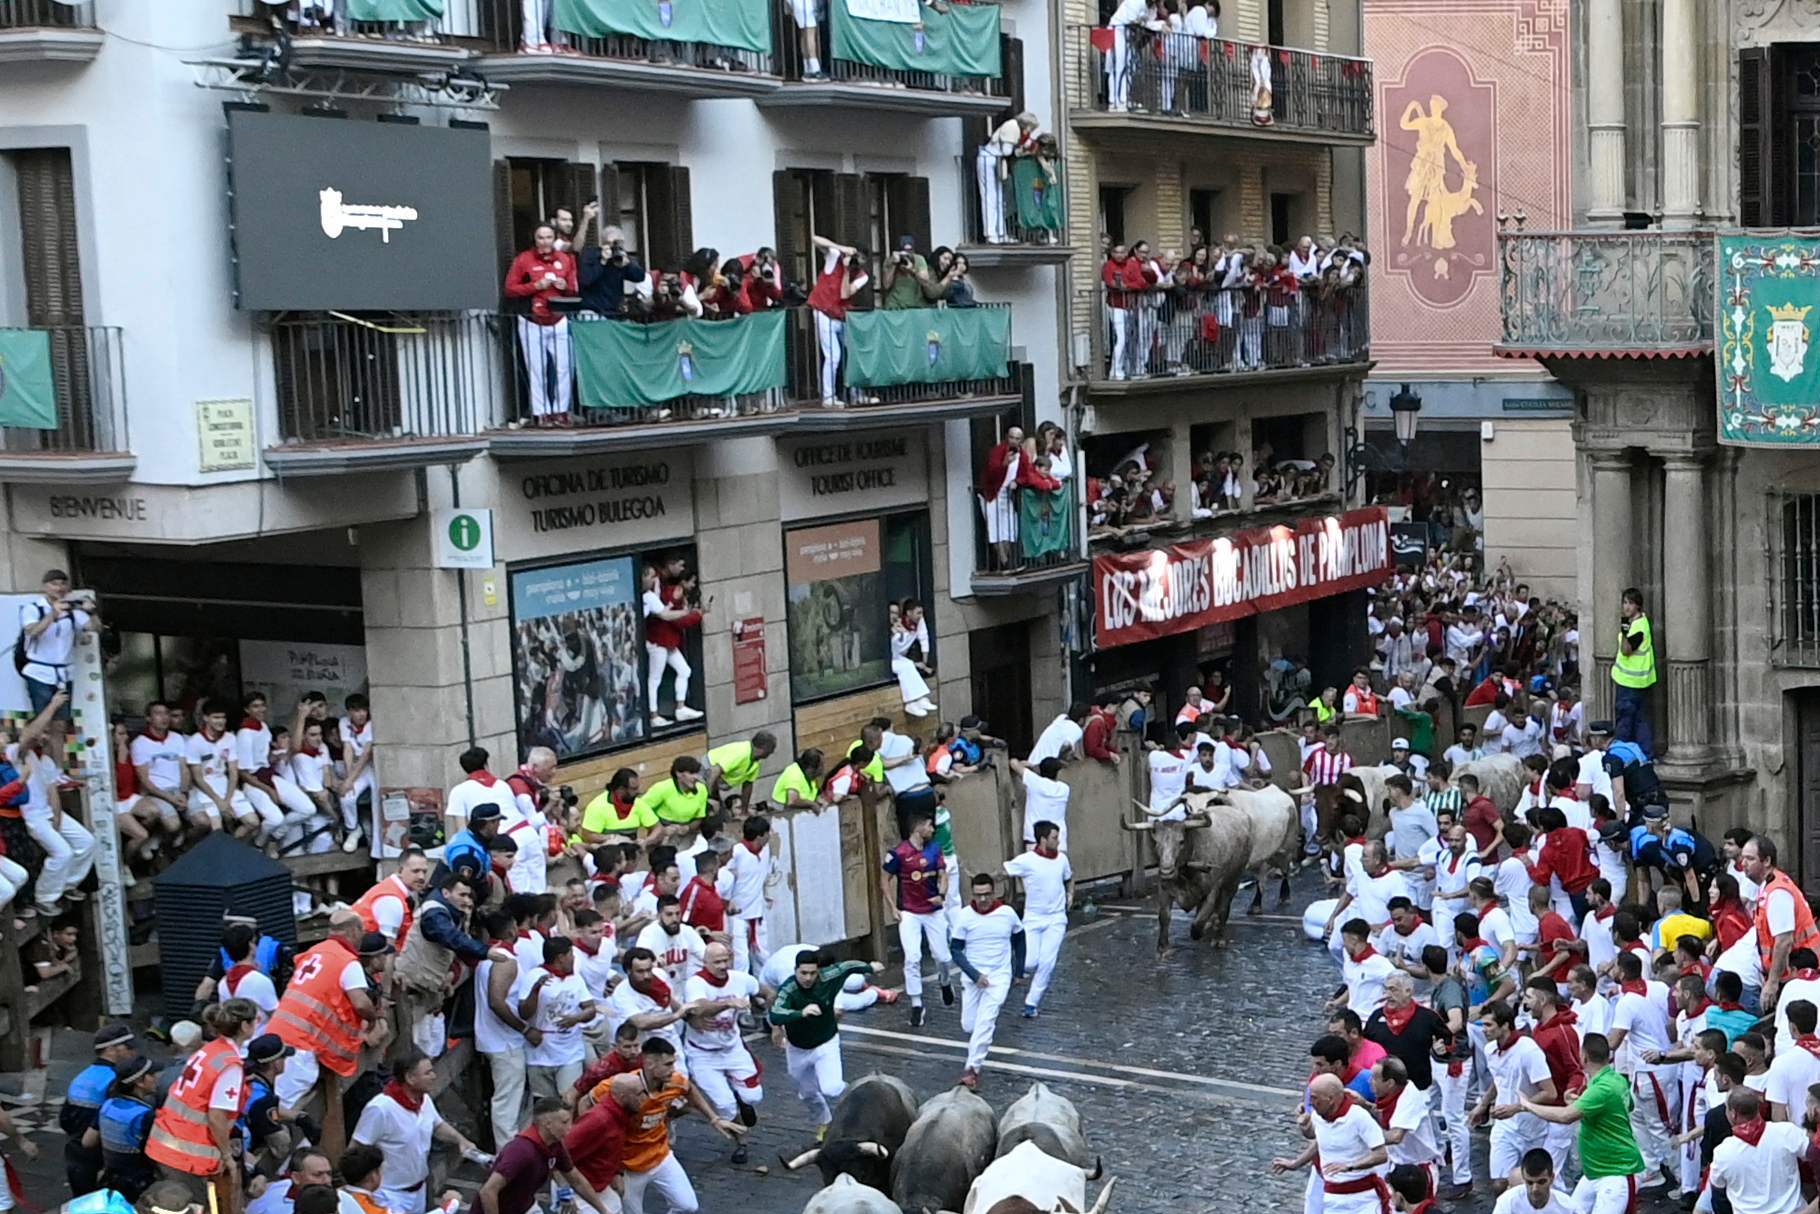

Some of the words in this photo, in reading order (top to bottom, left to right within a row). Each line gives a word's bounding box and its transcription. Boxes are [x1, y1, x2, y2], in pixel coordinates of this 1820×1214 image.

[794, 444, 833, 468] OFFICE
[834, 443, 853, 463] DE
[522, 470, 586, 500] OFICINA
[587, 468, 610, 492] DE
[609, 461, 670, 489] TURISMO
[811, 471, 855, 497] TOURIST
[856, 467, 897, 490] OFFICE
[49, 496, 147, 521] BIENVENUE
[532, 502, 596, 533] TURISMO
[598, 495, 666, 524] BULEGOA
[1102, 570, 1136, 630] LOS
[1138, 555, 1209, 622] MEJORES
[1212, 536, 1297, 608] BOCADILLOS
[1299, 534, 1316, 587] DE
[1317, 519, 1388, 583] PAMPLONA
